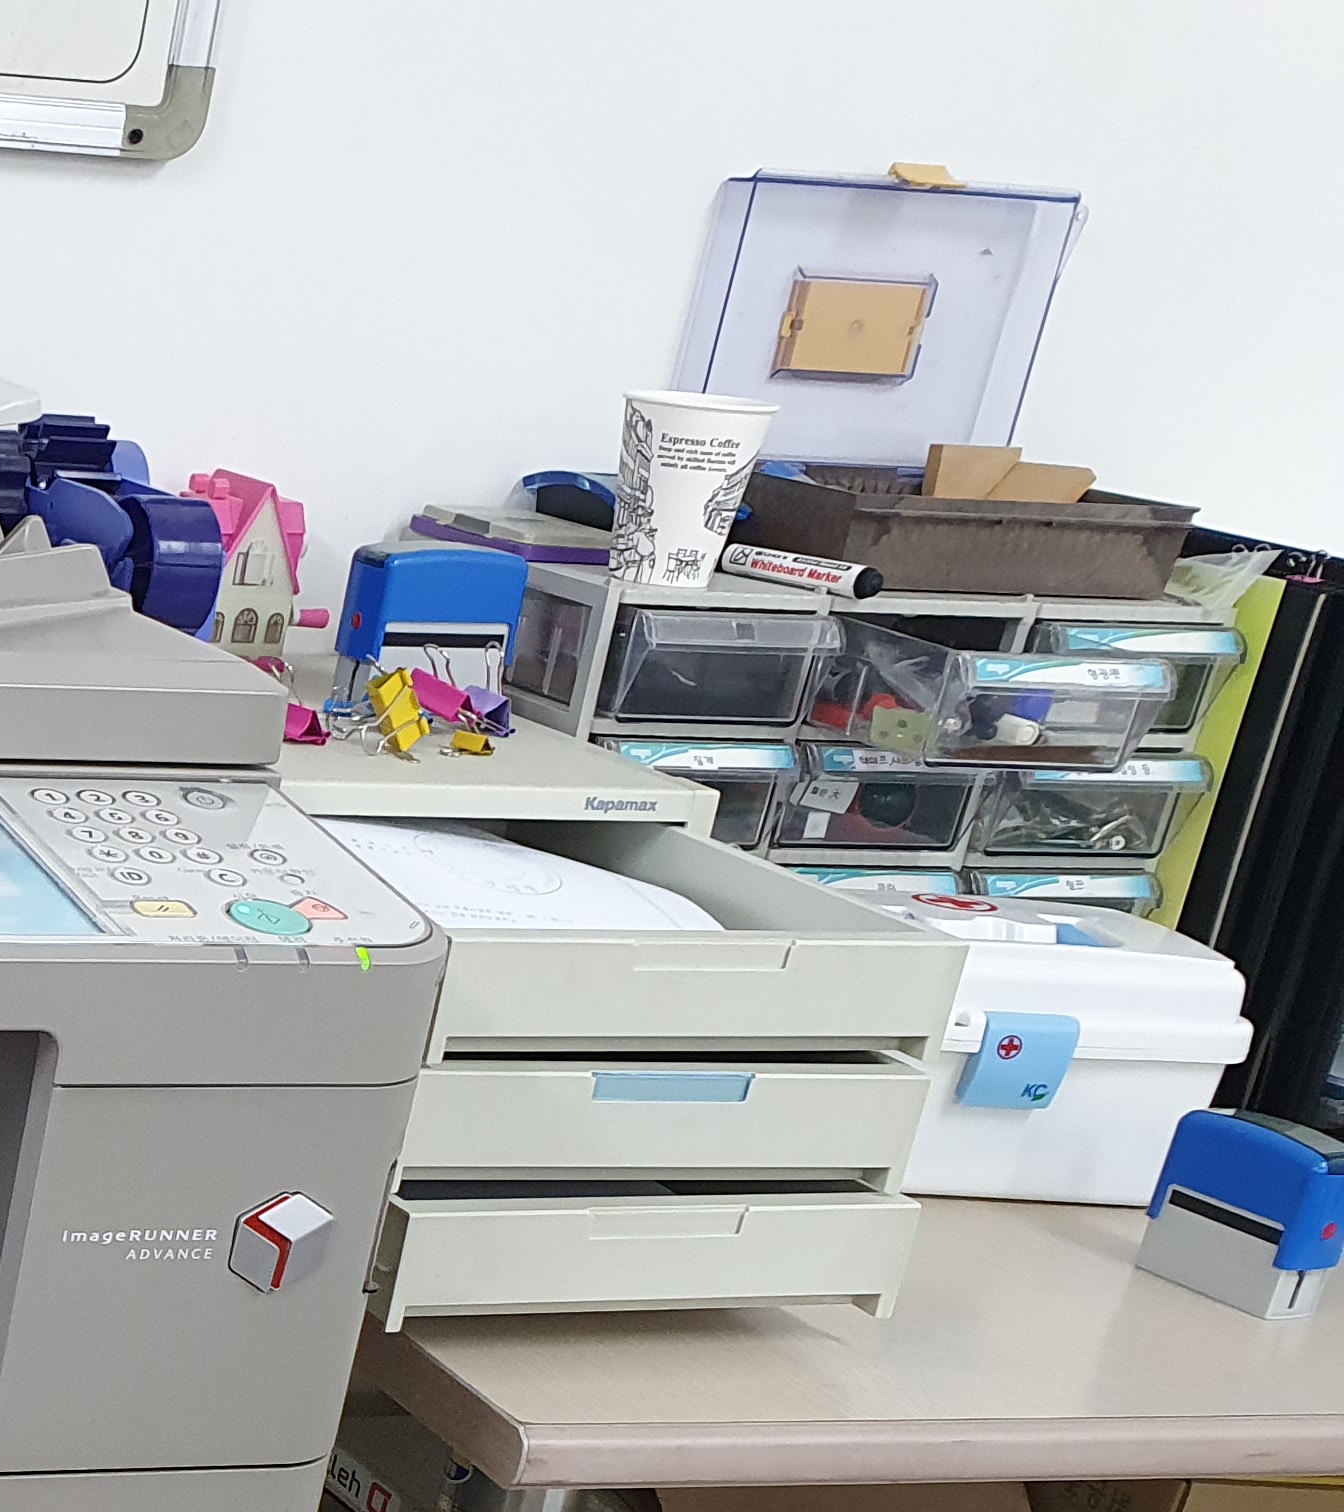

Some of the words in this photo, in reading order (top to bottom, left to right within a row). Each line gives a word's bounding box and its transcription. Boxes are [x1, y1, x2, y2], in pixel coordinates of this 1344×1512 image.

[660, 432, 707, 446] Espresso
[709, 437, 741, 449] Coffee
[750, 557, 808, 578] Whiteboard
[807, 567, 842, 583] Marker
[583, 796, 658, 814] Kapamax
[62, 1229, 218, 1245] imageRUNNER
[125, 1248, 213, 1260] ADVANCE
